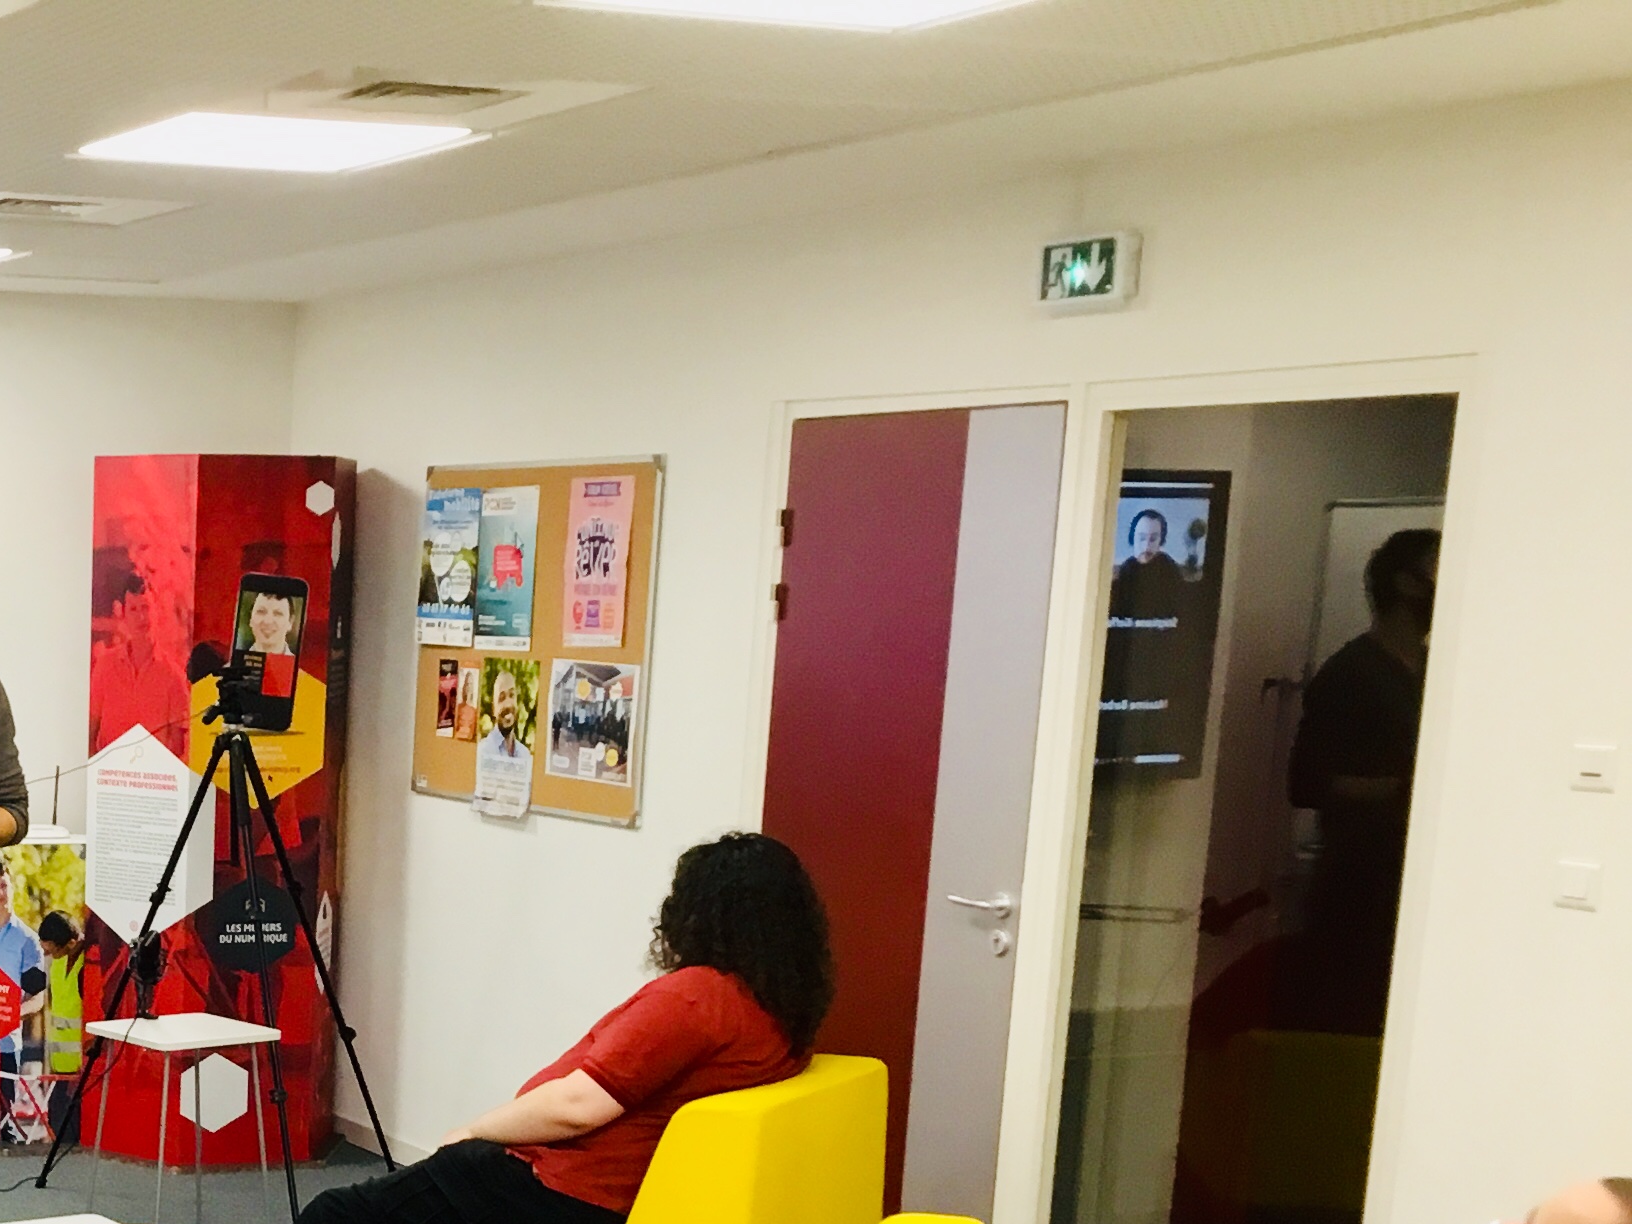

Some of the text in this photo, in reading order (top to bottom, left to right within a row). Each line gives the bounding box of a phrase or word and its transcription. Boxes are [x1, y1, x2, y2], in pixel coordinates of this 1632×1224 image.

[226, 922, 282, 933] LES MIERS
[219, 933, 288, 945] DU NUMIQUE
